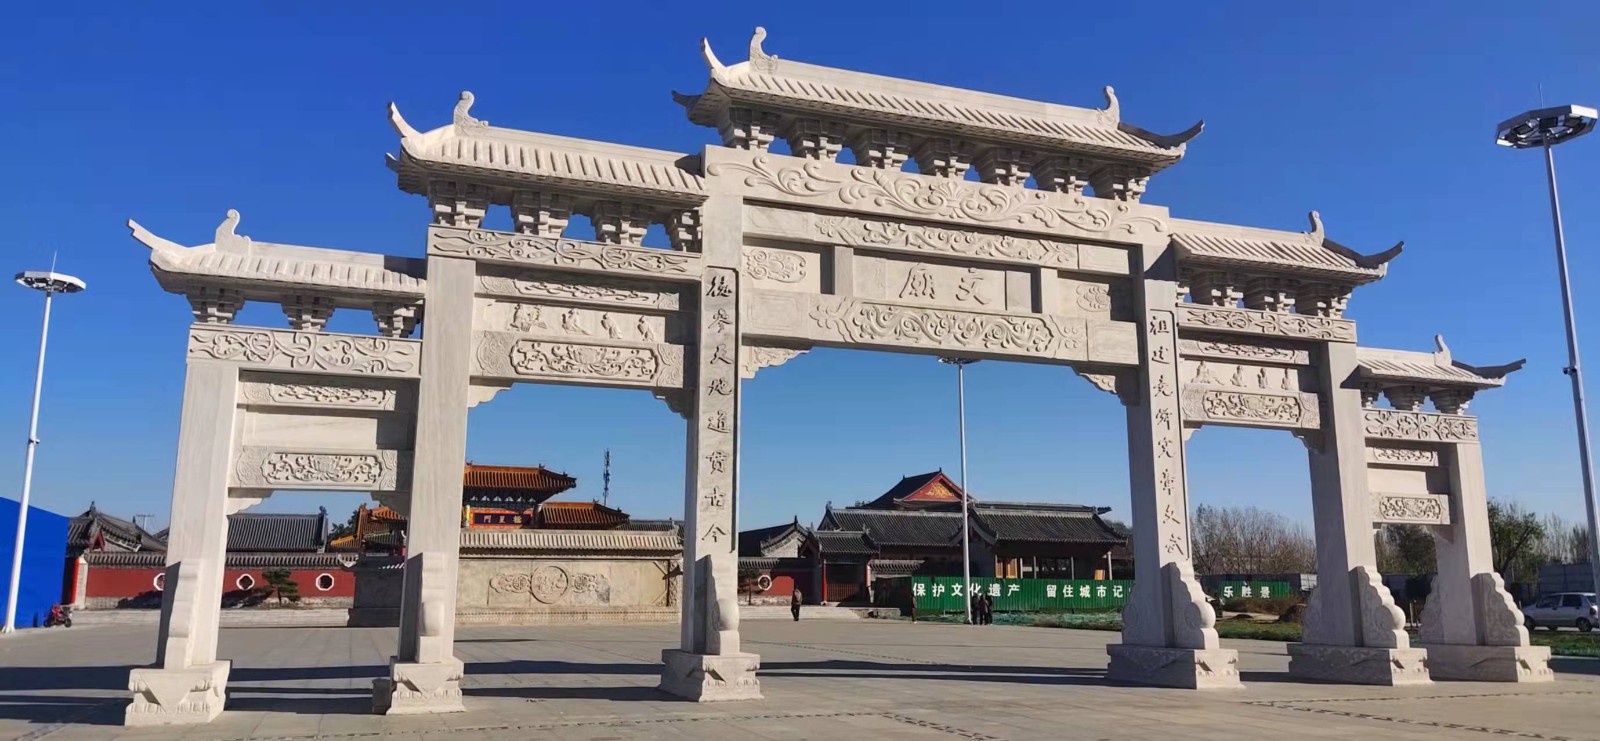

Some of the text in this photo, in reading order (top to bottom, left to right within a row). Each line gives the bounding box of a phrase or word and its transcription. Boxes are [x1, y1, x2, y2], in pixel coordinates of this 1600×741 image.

[912, 582, 1020, 598] 保护文化遗产
[1046, 584, 1131, 598] 留住城市记
